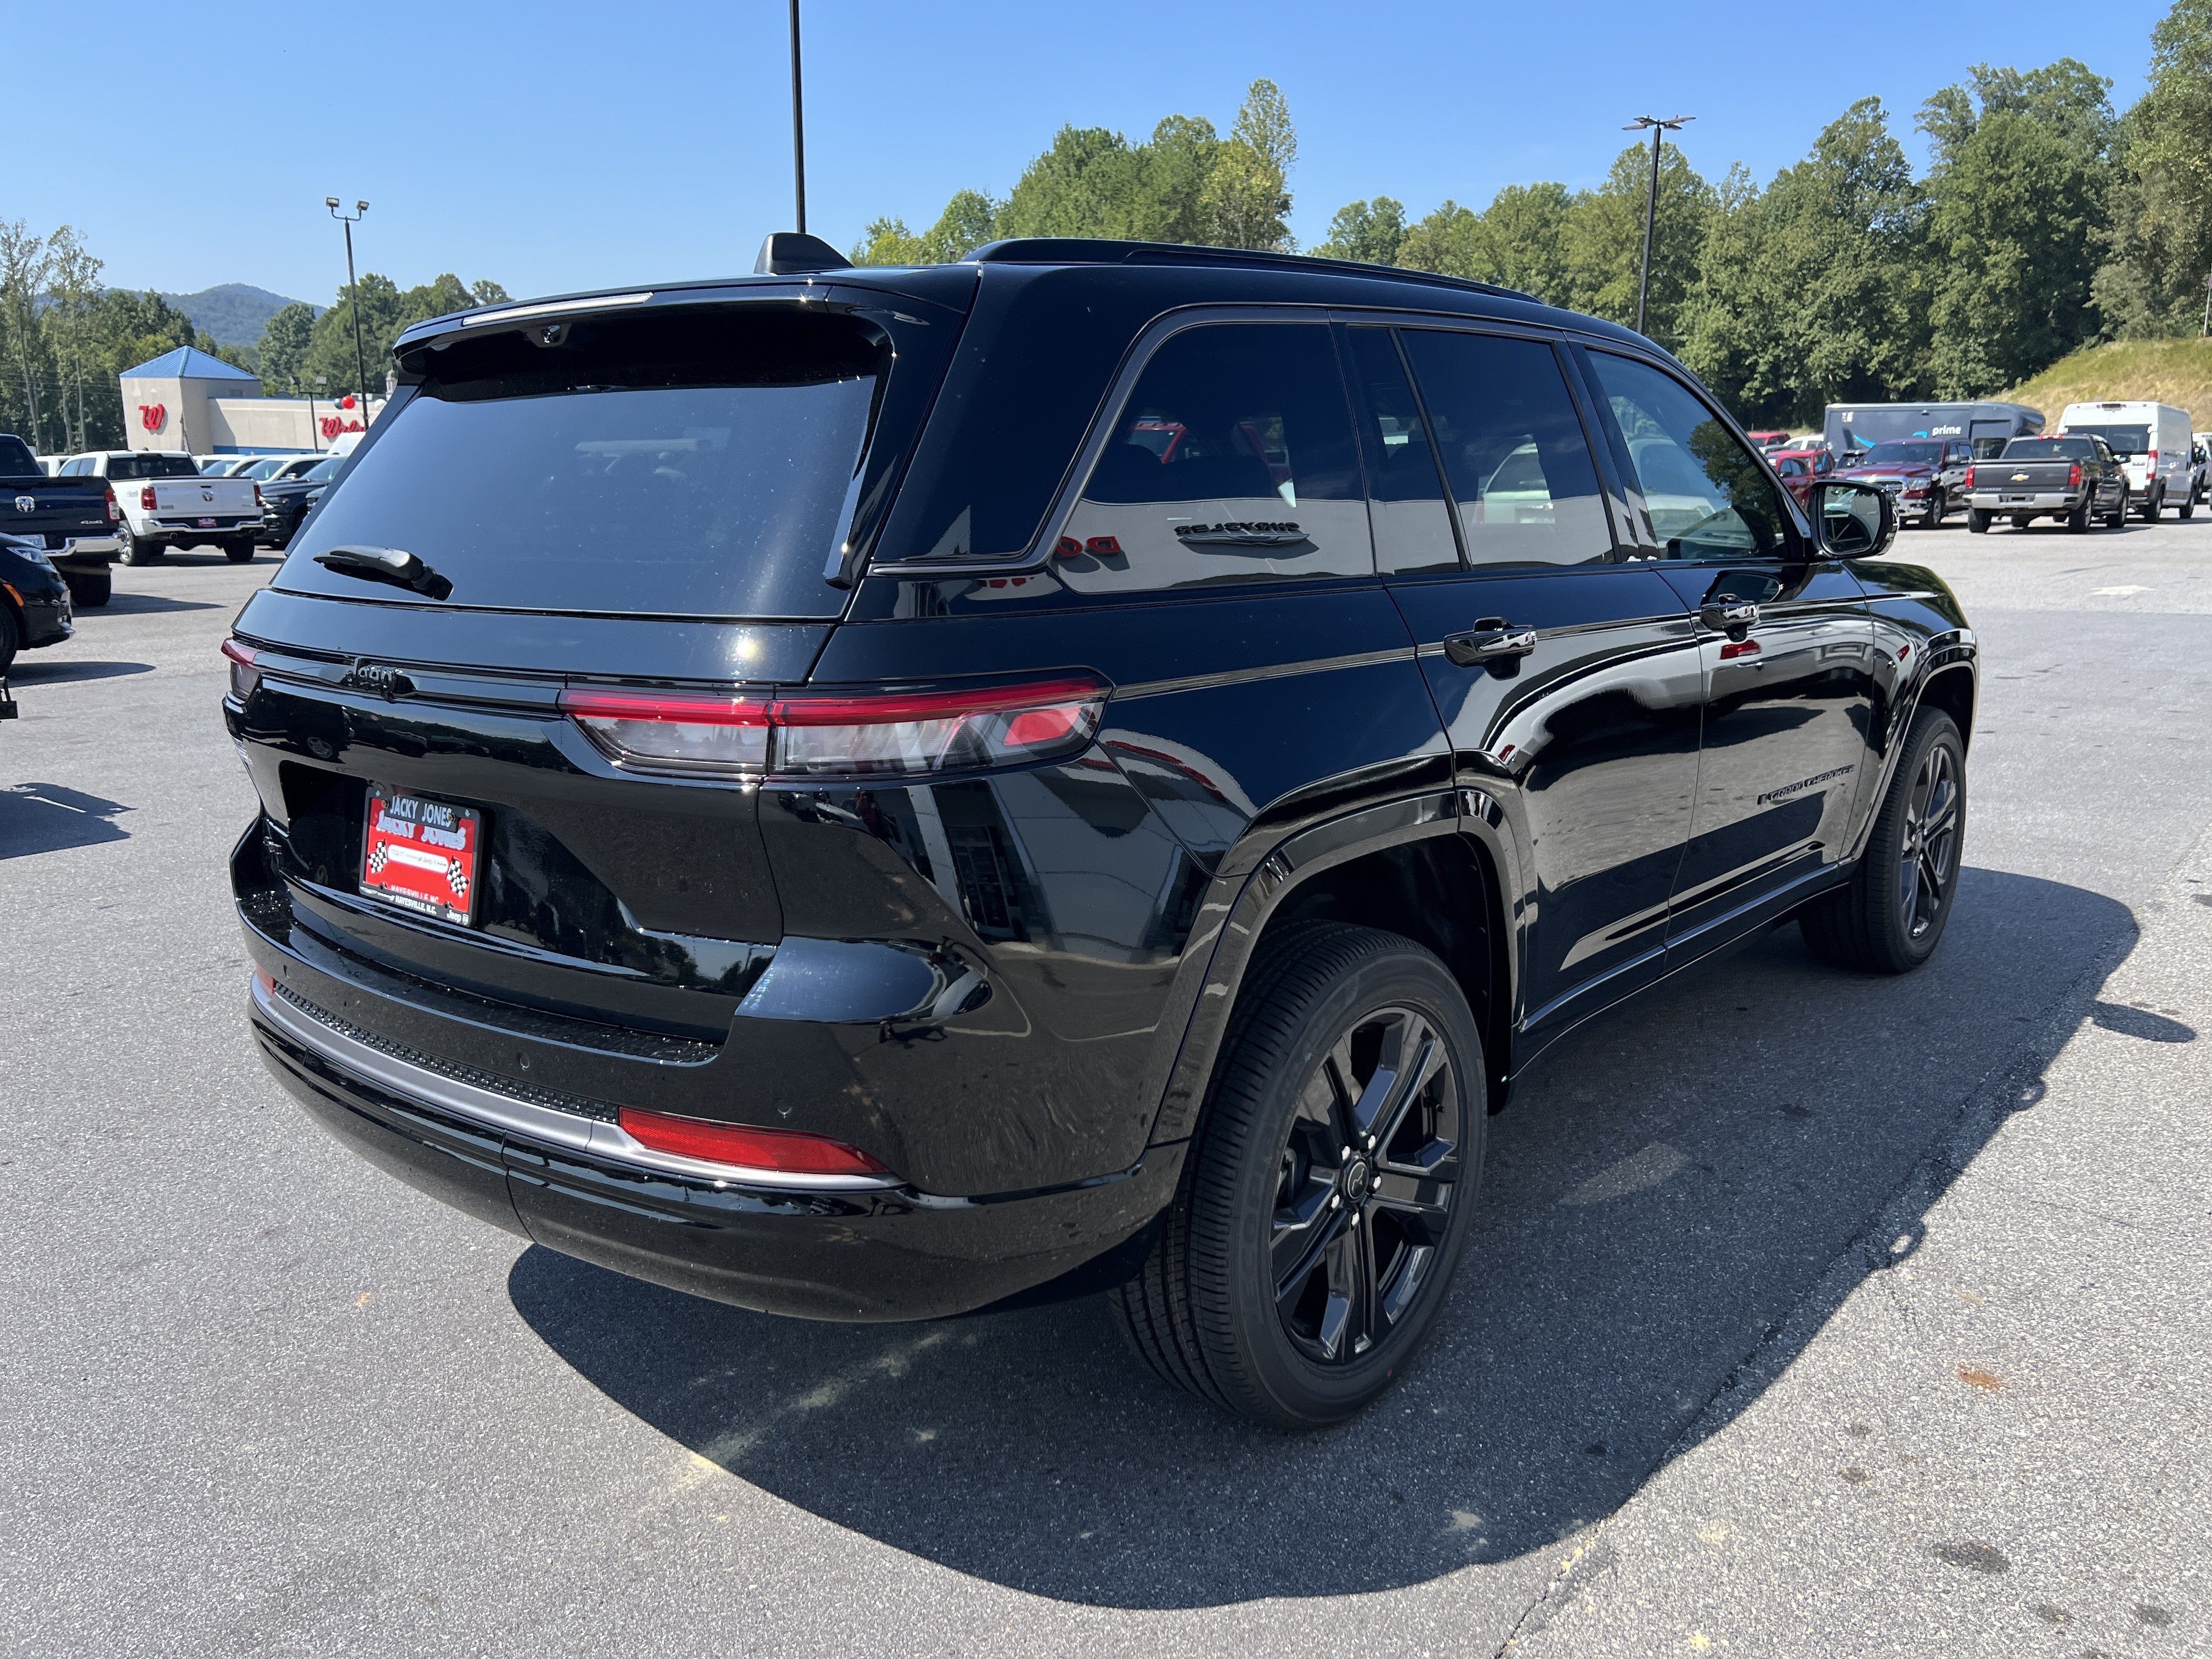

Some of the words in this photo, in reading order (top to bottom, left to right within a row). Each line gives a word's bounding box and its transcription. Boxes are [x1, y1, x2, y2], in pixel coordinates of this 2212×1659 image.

[138, 403, 164, 430] W
[1932, 425, 1962, 437] prime
[390, 796, 419, 819] JACKY
[421, 803, 453, 827] JONES
[376, 810, 416, 838] JACKY
[421, 825, 466, 850] JONES
[447, 909, 462, 923] Jeep
